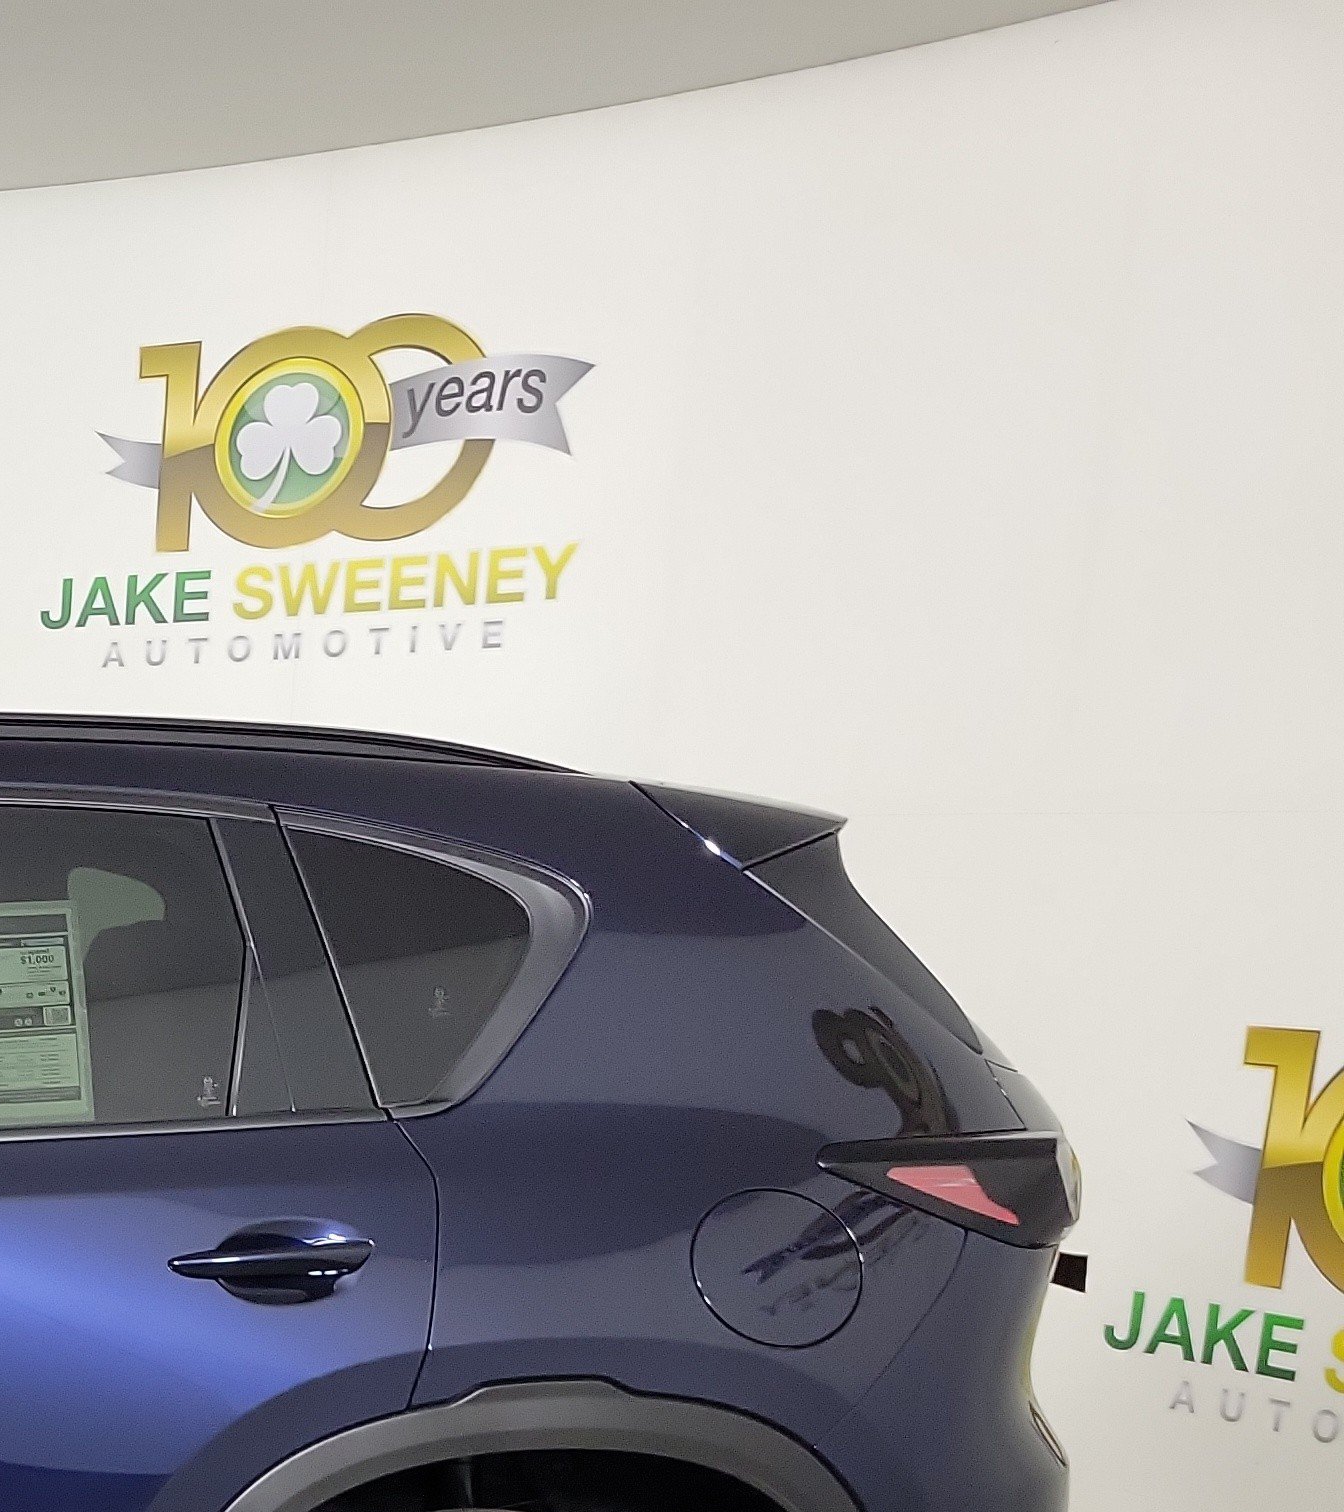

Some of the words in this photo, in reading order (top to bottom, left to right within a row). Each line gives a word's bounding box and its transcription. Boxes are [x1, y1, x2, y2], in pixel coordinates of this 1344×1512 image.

[138, 313, 495, 553] 100
[402, 366, 548, 439] years
[39, 569, 212, 630] JAKE
[232, 542, 580, 621] SWEENEY
[101, 619, 506, 668] AUTOMOTIVE
[1103, 1290, 1305, 1382] JAKE
[1169, 1380, 1340, 1444] AUTO
